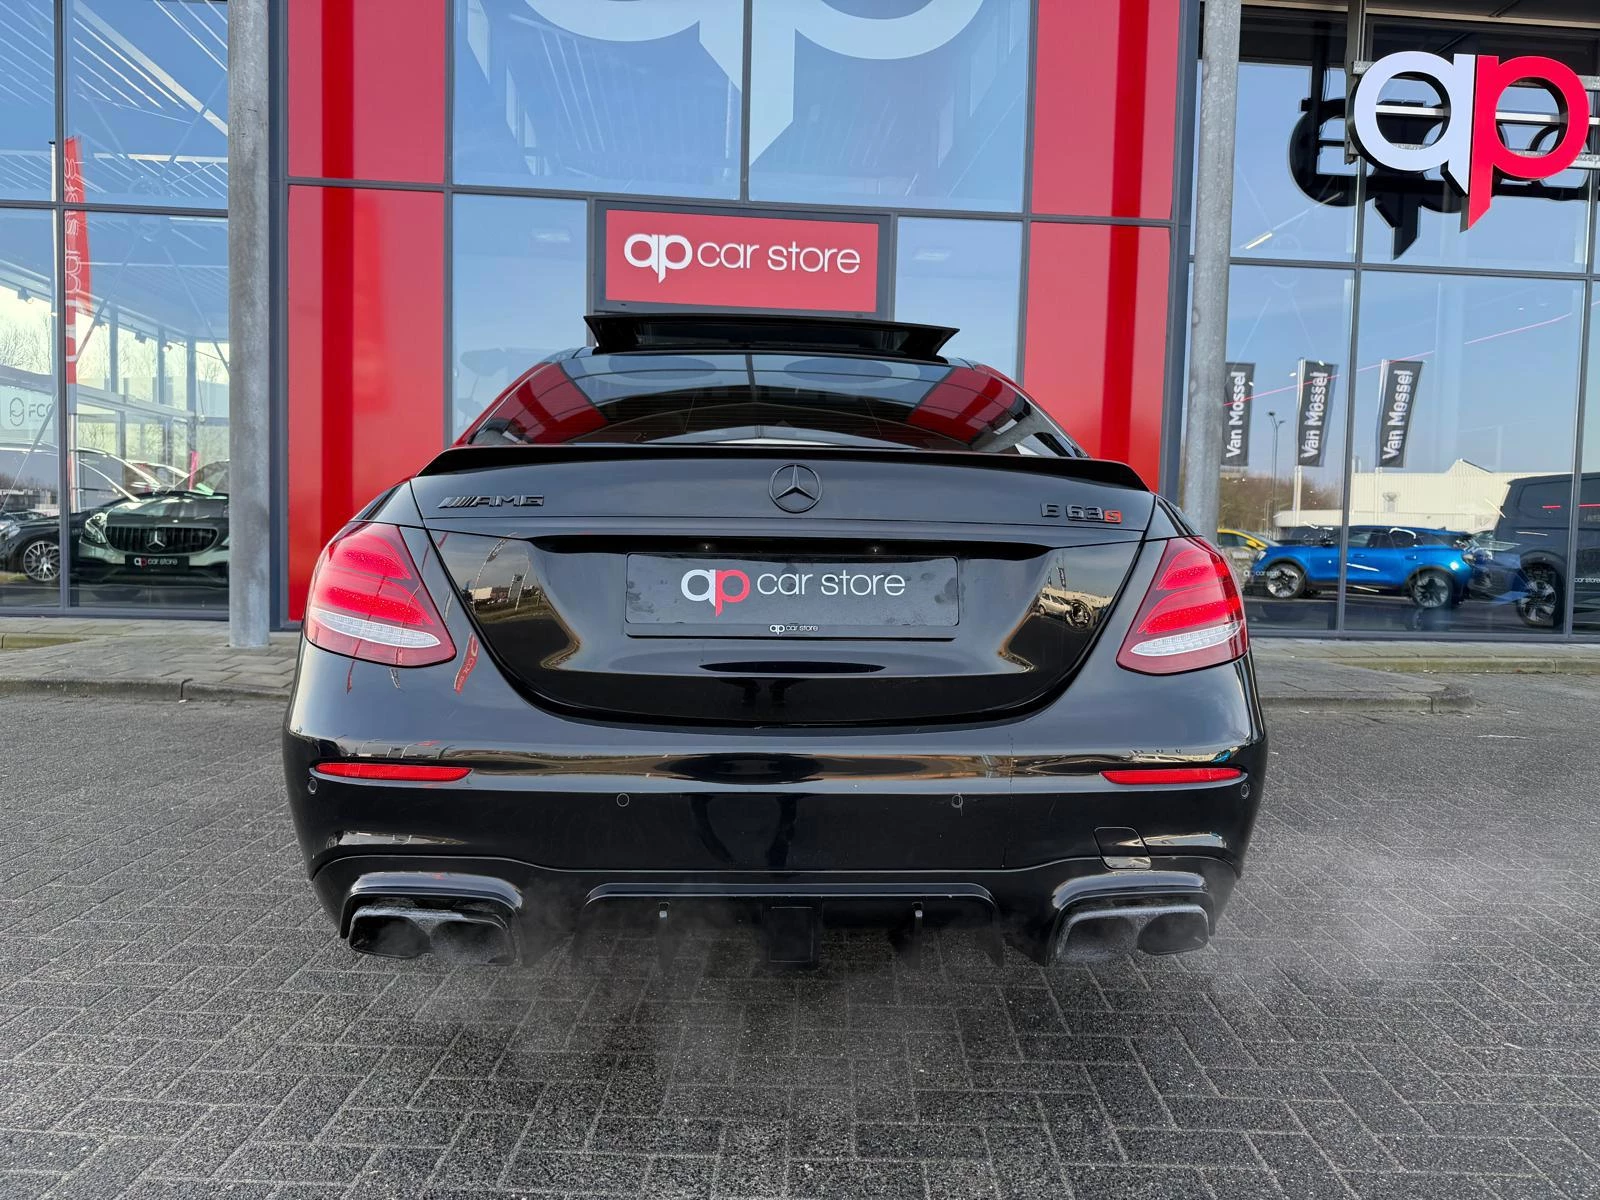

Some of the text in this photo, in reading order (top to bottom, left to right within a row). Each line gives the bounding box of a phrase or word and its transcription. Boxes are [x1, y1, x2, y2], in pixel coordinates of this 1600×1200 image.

[1352, 51, 1590, 231] ap
[624, 233, 860, 284] ap car store
[1226, 371, 1246, 457] Van Mossel
[1300, 372, 1328, 457] Van Mossel
[1382, 370, 1414, 459] Van Mossel
[1040, 503, 1060, 518] E
[681, 569, 906, 617] ap car store
[770, 624, 785, 635] ap
[799, 624, 819, 632] store
